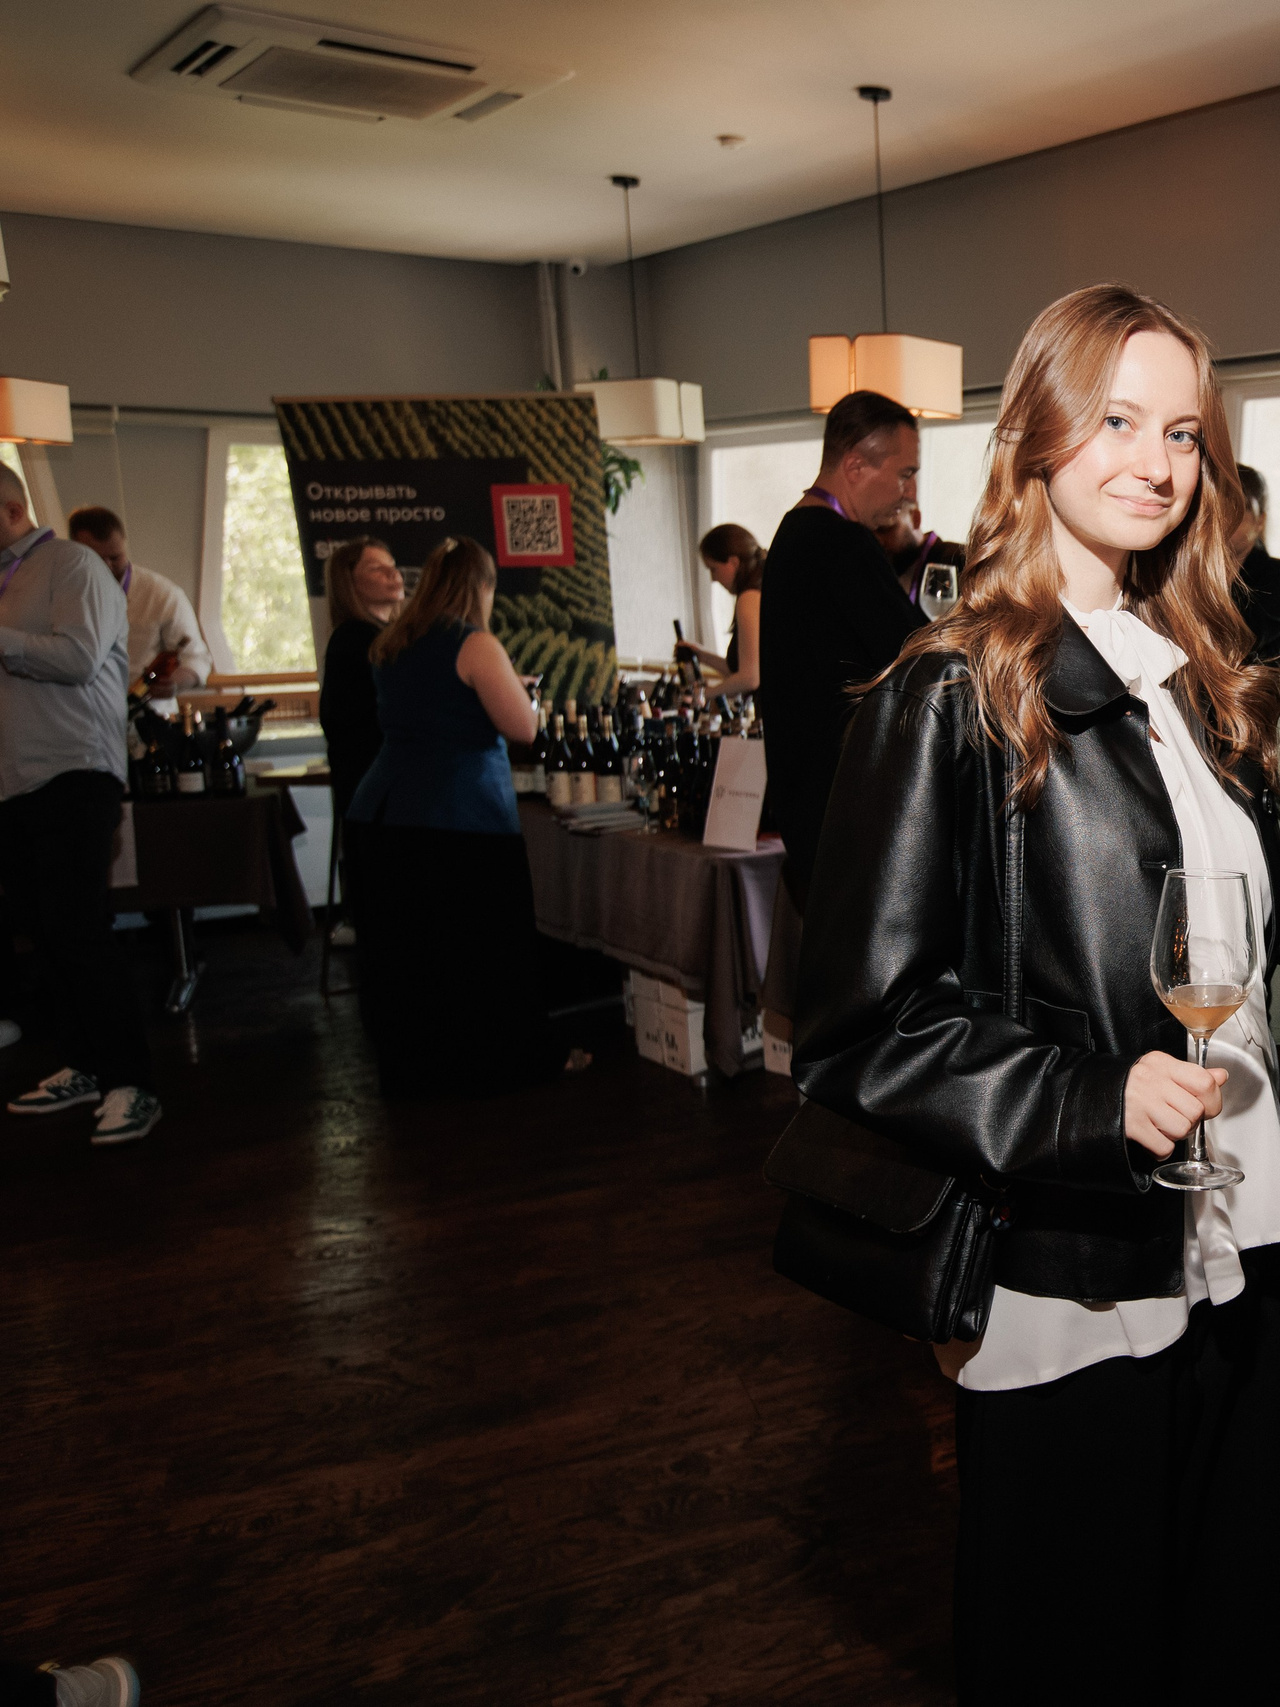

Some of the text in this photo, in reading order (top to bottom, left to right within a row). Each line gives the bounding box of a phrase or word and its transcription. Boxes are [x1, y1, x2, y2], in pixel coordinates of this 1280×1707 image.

[306, 481, 417, 503] Открывать
[310, 506, 445, 525] новое просто
